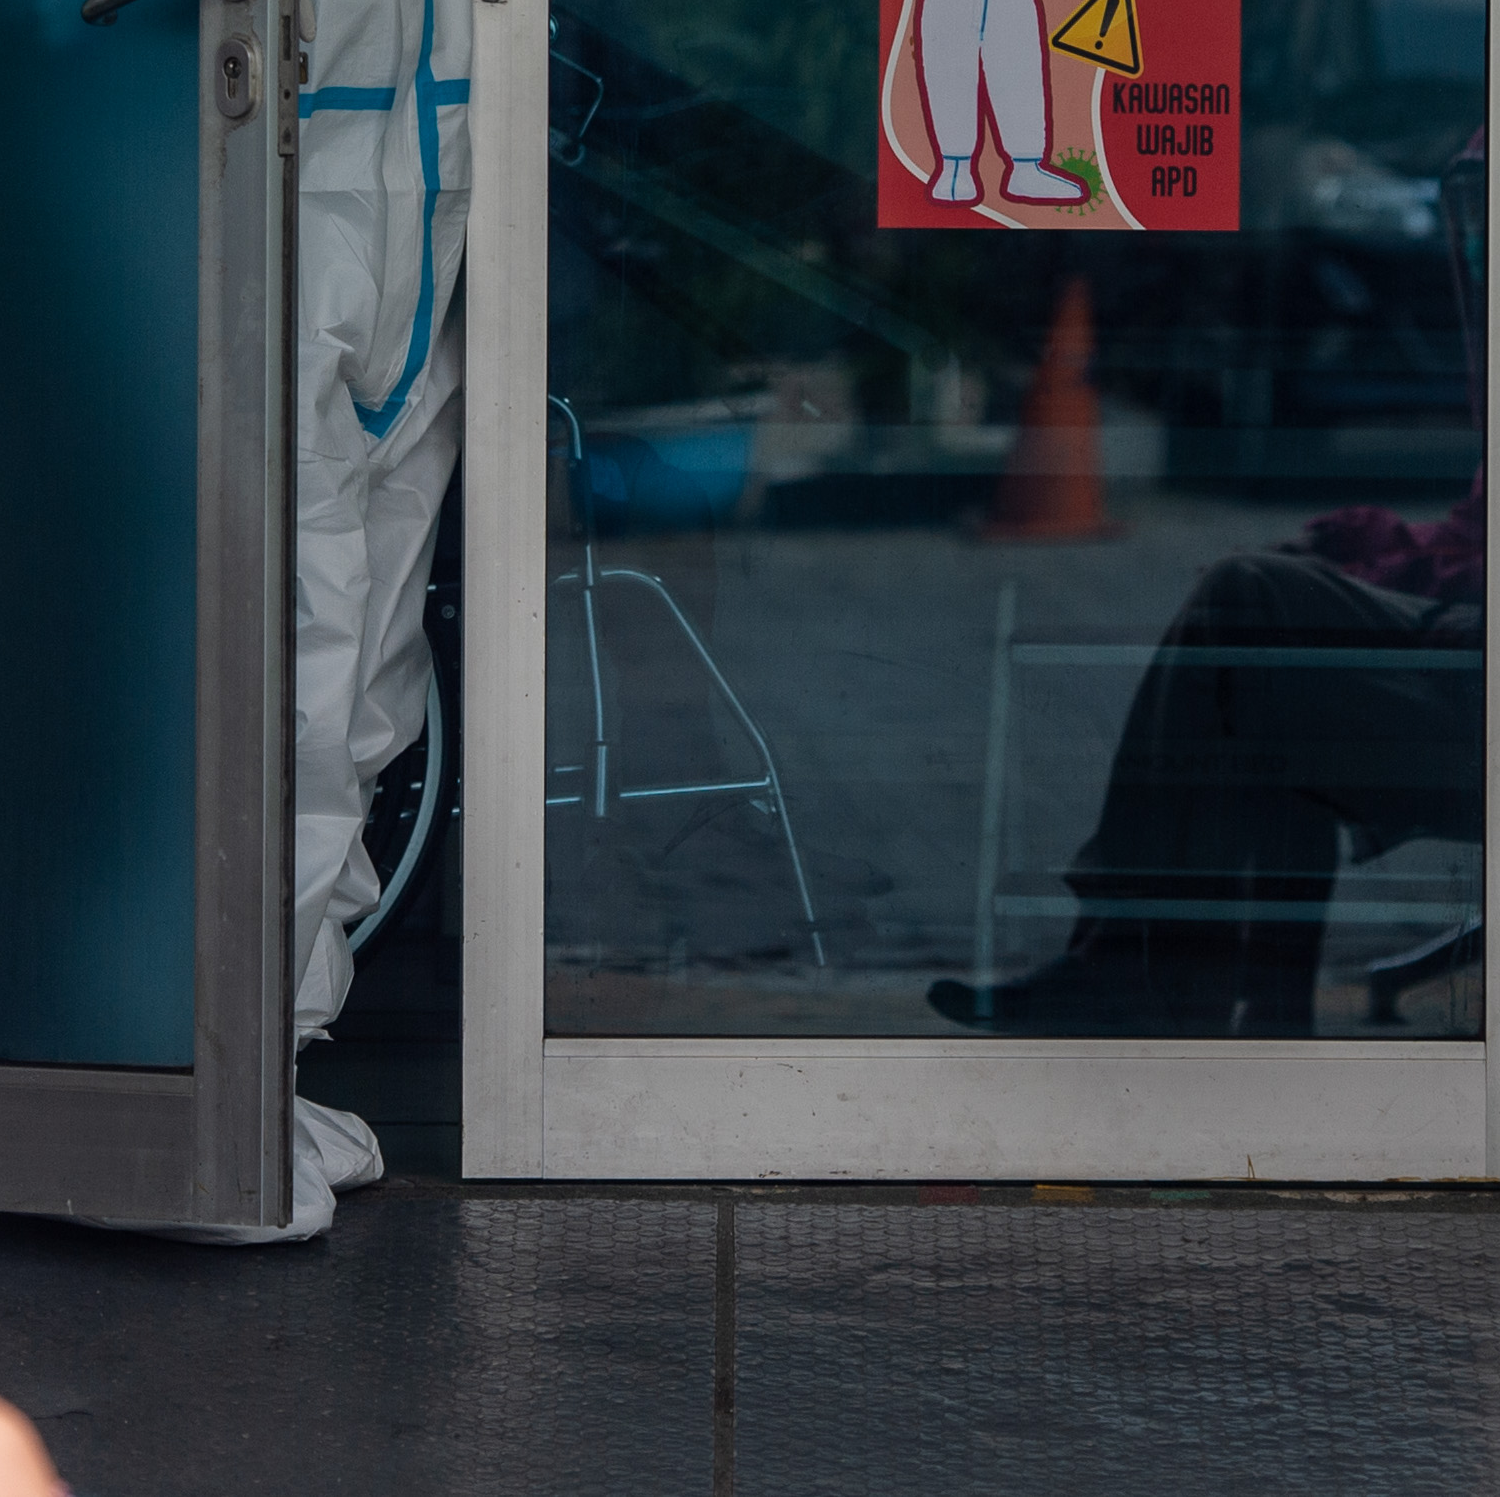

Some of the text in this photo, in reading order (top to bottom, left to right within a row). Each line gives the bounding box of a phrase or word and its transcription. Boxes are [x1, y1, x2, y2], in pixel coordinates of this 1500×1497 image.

[1112, 83, 1230, 115] KAWASAN
[1136, 124, 1214, 156] WAJIB
[1151, 166, 1198, 198] APD
